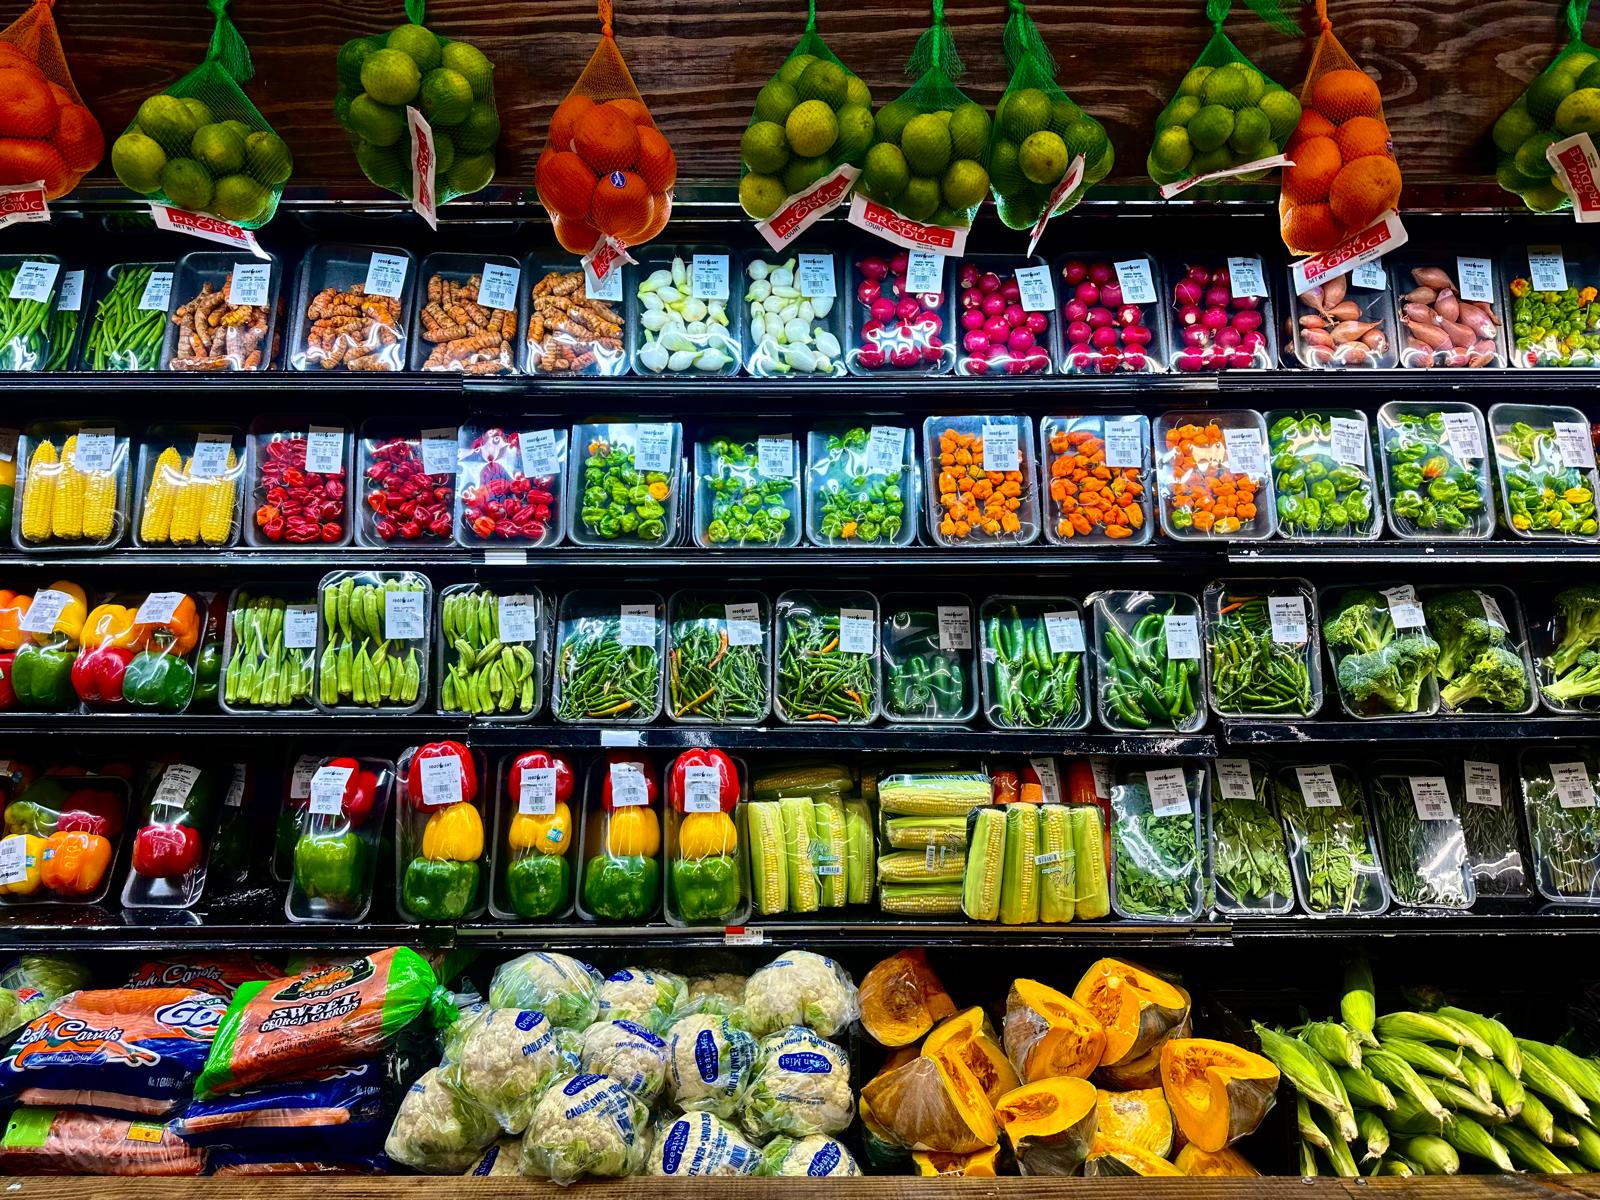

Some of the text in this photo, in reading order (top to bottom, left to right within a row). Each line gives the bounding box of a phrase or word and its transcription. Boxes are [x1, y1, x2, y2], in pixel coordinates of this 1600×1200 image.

[1570, 147, 1600, 208] PRODUCE
[173, 222, 186, 230] NET
[784, 224, 802, 241] COUNT
[865, 221, 885, 232] COUNT
[866, 211, 951, 247] PRODUCE
[890, 213, 927, 235] Fresh
[1307, 231, 1388, 278] PRODUCE
[162, 964, 224, 985] Carrots
[299, 981, 347, 998] GARDENS
[260, 1000, 360, 1032] GEORGIA CARROTS
[269, 992, 358, 1018] SWEET
[54, 1018, 125, 1042] Carrots
[703, 1050, 714, 1081] Ocean
[725, 1046, 741, 1097] CAULIFLOWER
[779, 1056, 802, 1067] Mist
[666, 1140, 678, 1171] Ocean
